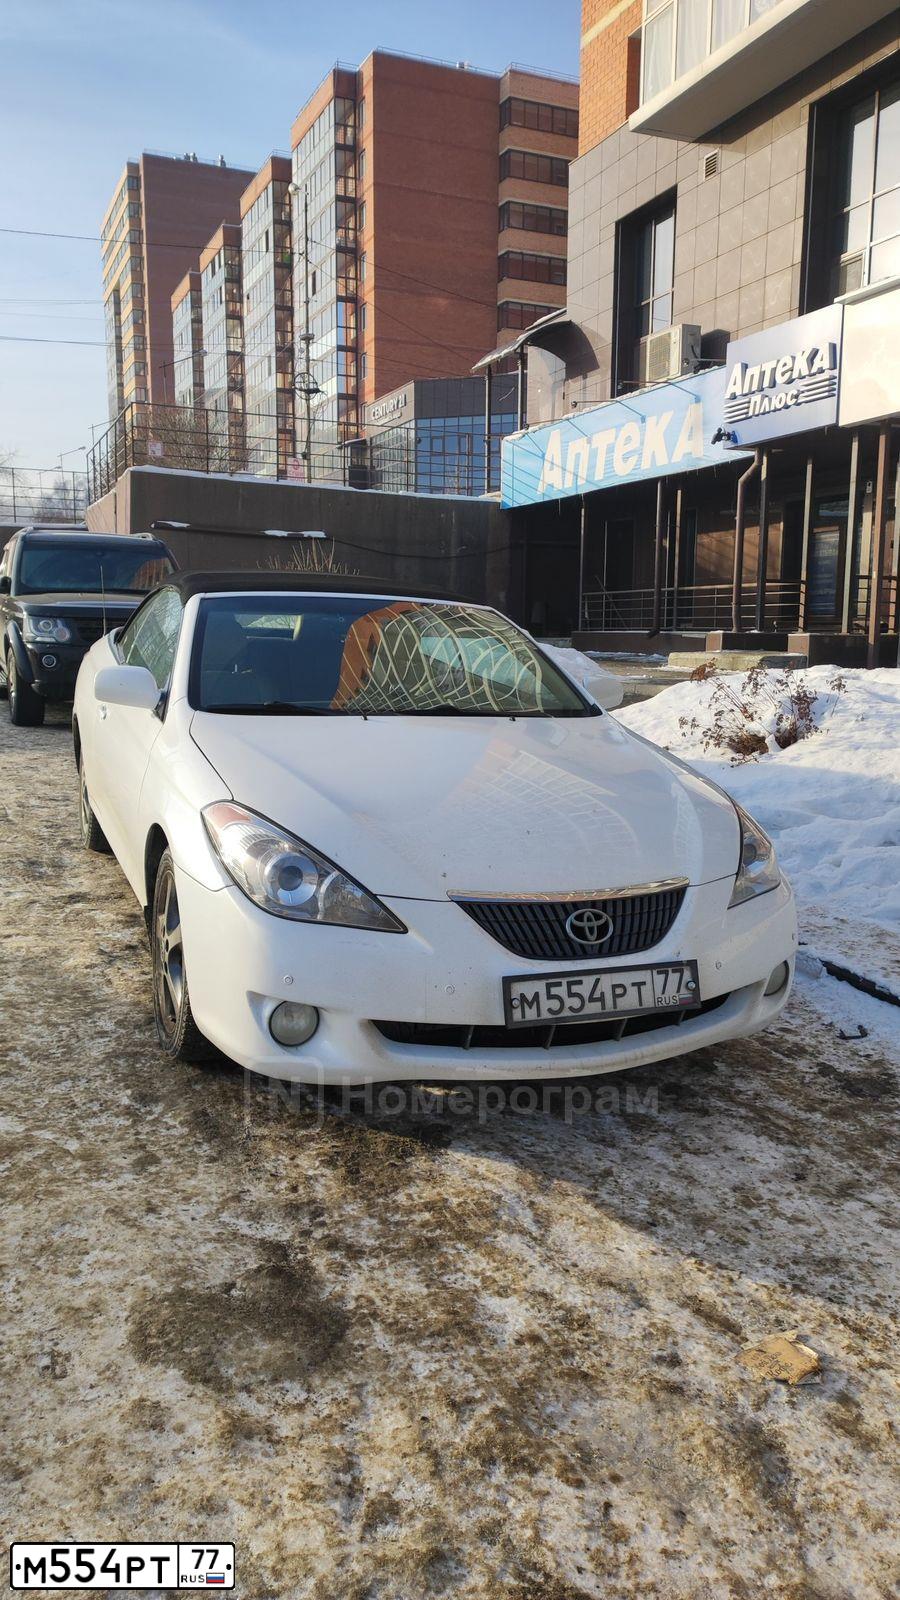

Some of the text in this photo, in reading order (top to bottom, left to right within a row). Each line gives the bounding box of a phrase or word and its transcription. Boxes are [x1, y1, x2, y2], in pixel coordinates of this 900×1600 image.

[371, 396, 400, 420] CENTURY
[748, 389, 803, 419] Плюс
[656, 967, 685, 995] 77
[656, 994, 679, 1007] RUS
